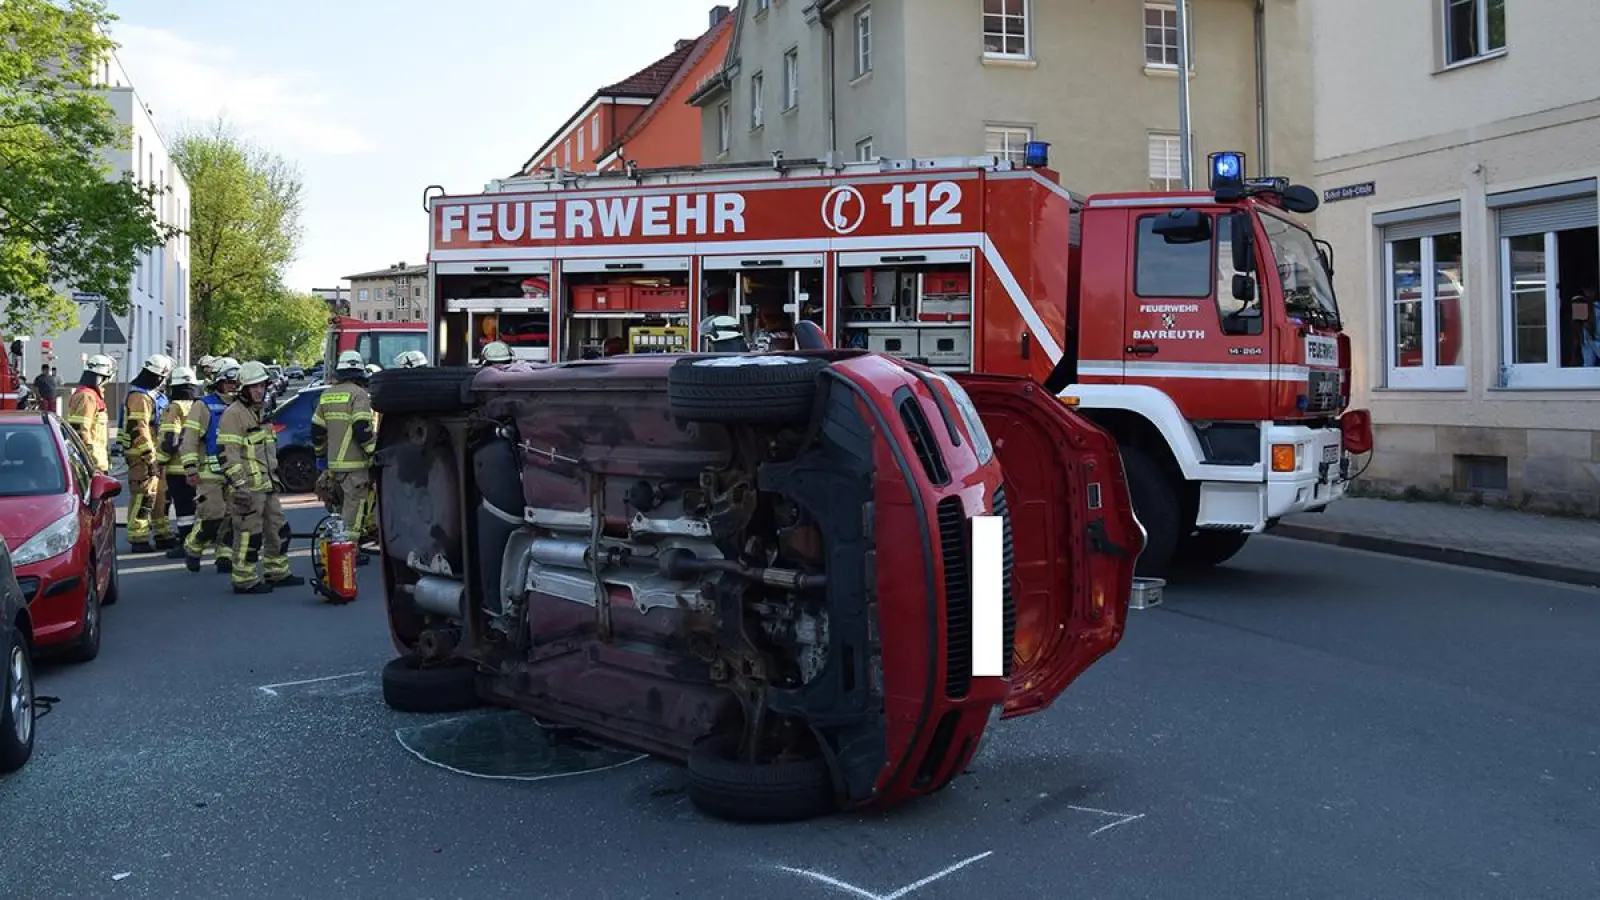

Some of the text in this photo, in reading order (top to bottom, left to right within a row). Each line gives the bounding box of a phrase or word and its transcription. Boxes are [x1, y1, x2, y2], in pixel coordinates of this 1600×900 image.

[441, 181, 962, 242] FEUERWEHR 112
[1140, 304, 1199, 313] FEUERWEHR
[1132, 330, 1205, 340] BAYREUTH
